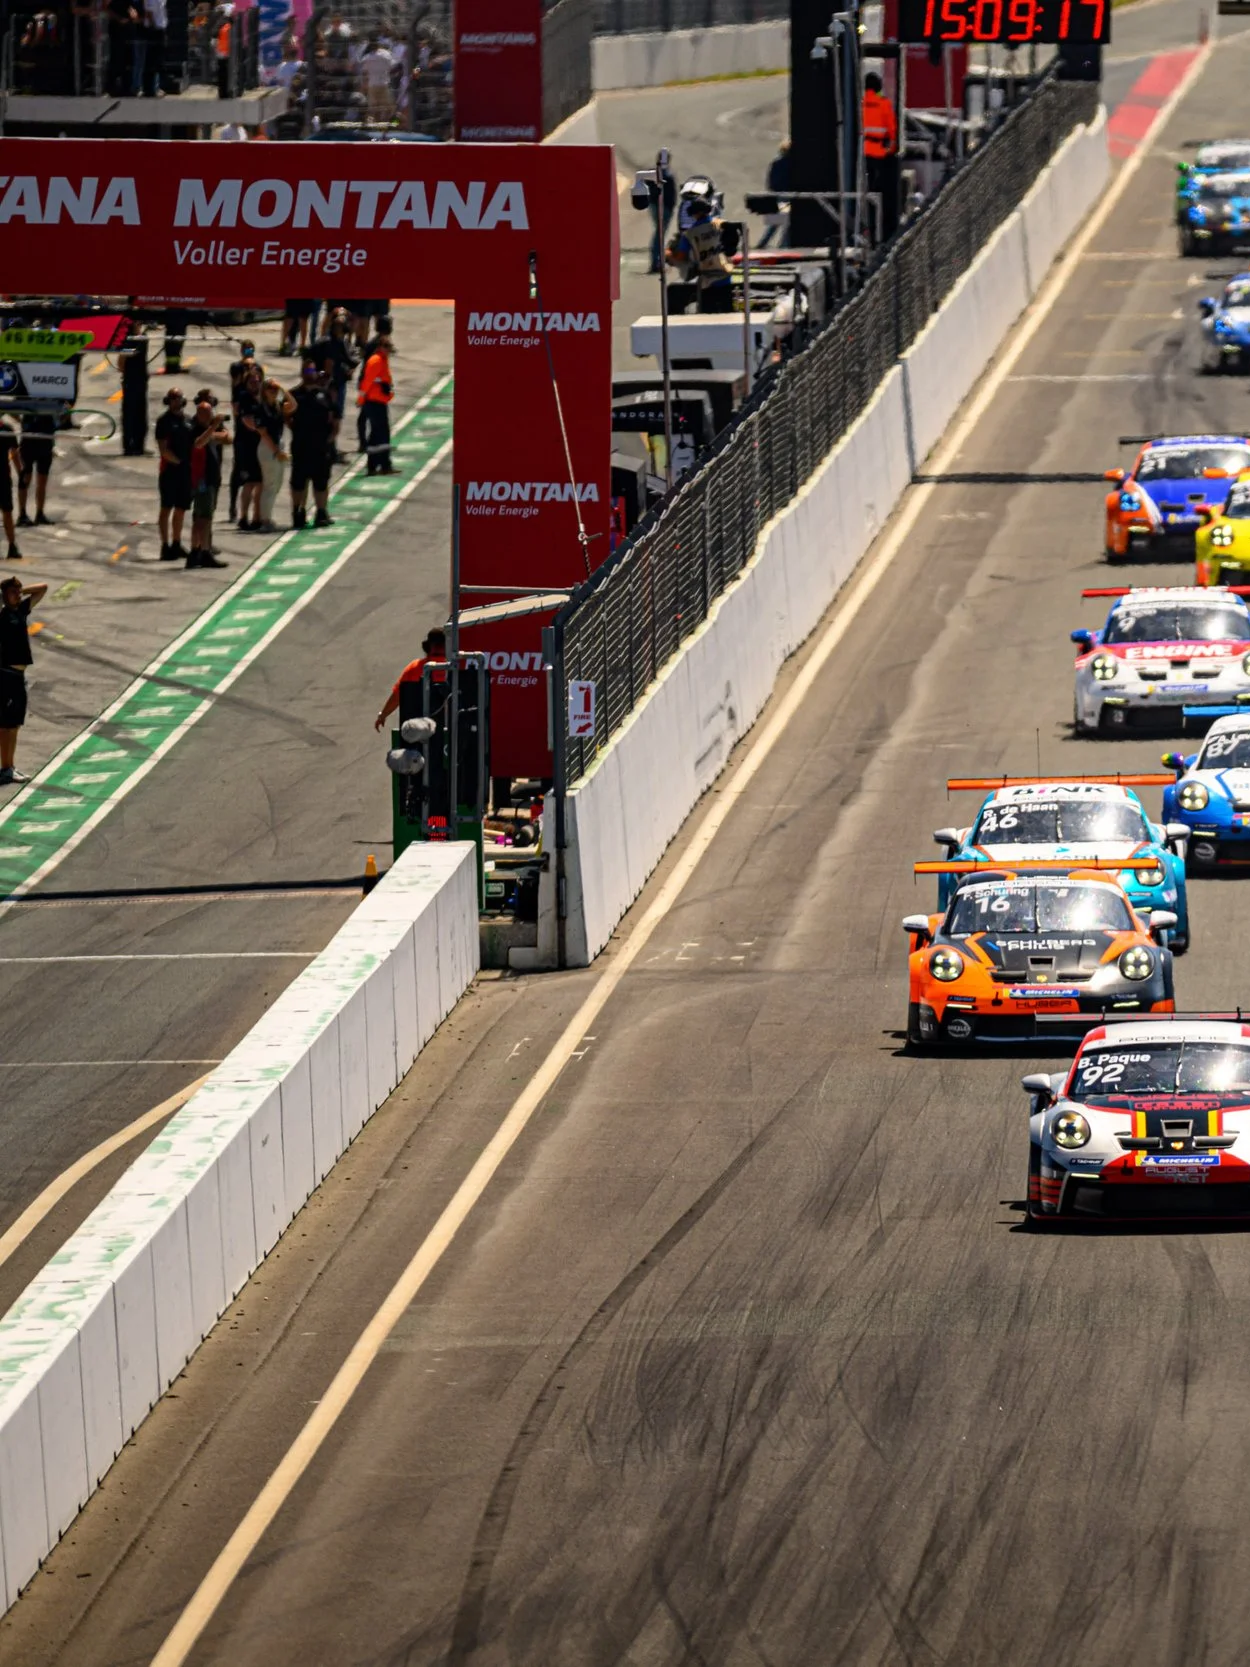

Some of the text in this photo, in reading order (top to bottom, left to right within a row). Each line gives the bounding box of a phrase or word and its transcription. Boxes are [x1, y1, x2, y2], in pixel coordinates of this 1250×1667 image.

[923, 0, 1106, 41] 15:09:17
[173, 178, 530, 230] MONTANA
[174, 240, 367, 273] Voller Energie
[467, 312, 601, 332] MONTANA
[467, 335, 540, 348] Voller Energie
[466, 481, 600, 502] MONTANA
[466, 504, 540, 518] Voller Energie
[1118, 616, 1137, 633] 9
[1125, 644, 1233, 660] ENGINE
[497, 675, 538, 688] Energie
[1000, 804, 1018, 814] de
[1020, 802, 1059, 812] Haan
[980, 813, 1018, 833] 46
[975, 886, 1030, 899] Schuring
[975, 895, 1011, 914] 16
[1024, 988, 1074, 996] MICHELIN
[1015, 1000, 1073, 1010] HUBER
[1077, 1054, 1151, 1069] B. Paque
[1082, 1063, 1125, 1087] 92
[1158, 1156, 1215, 1164] MICHELIN
[1145, 1166, 1210, 1174] AUGUST
